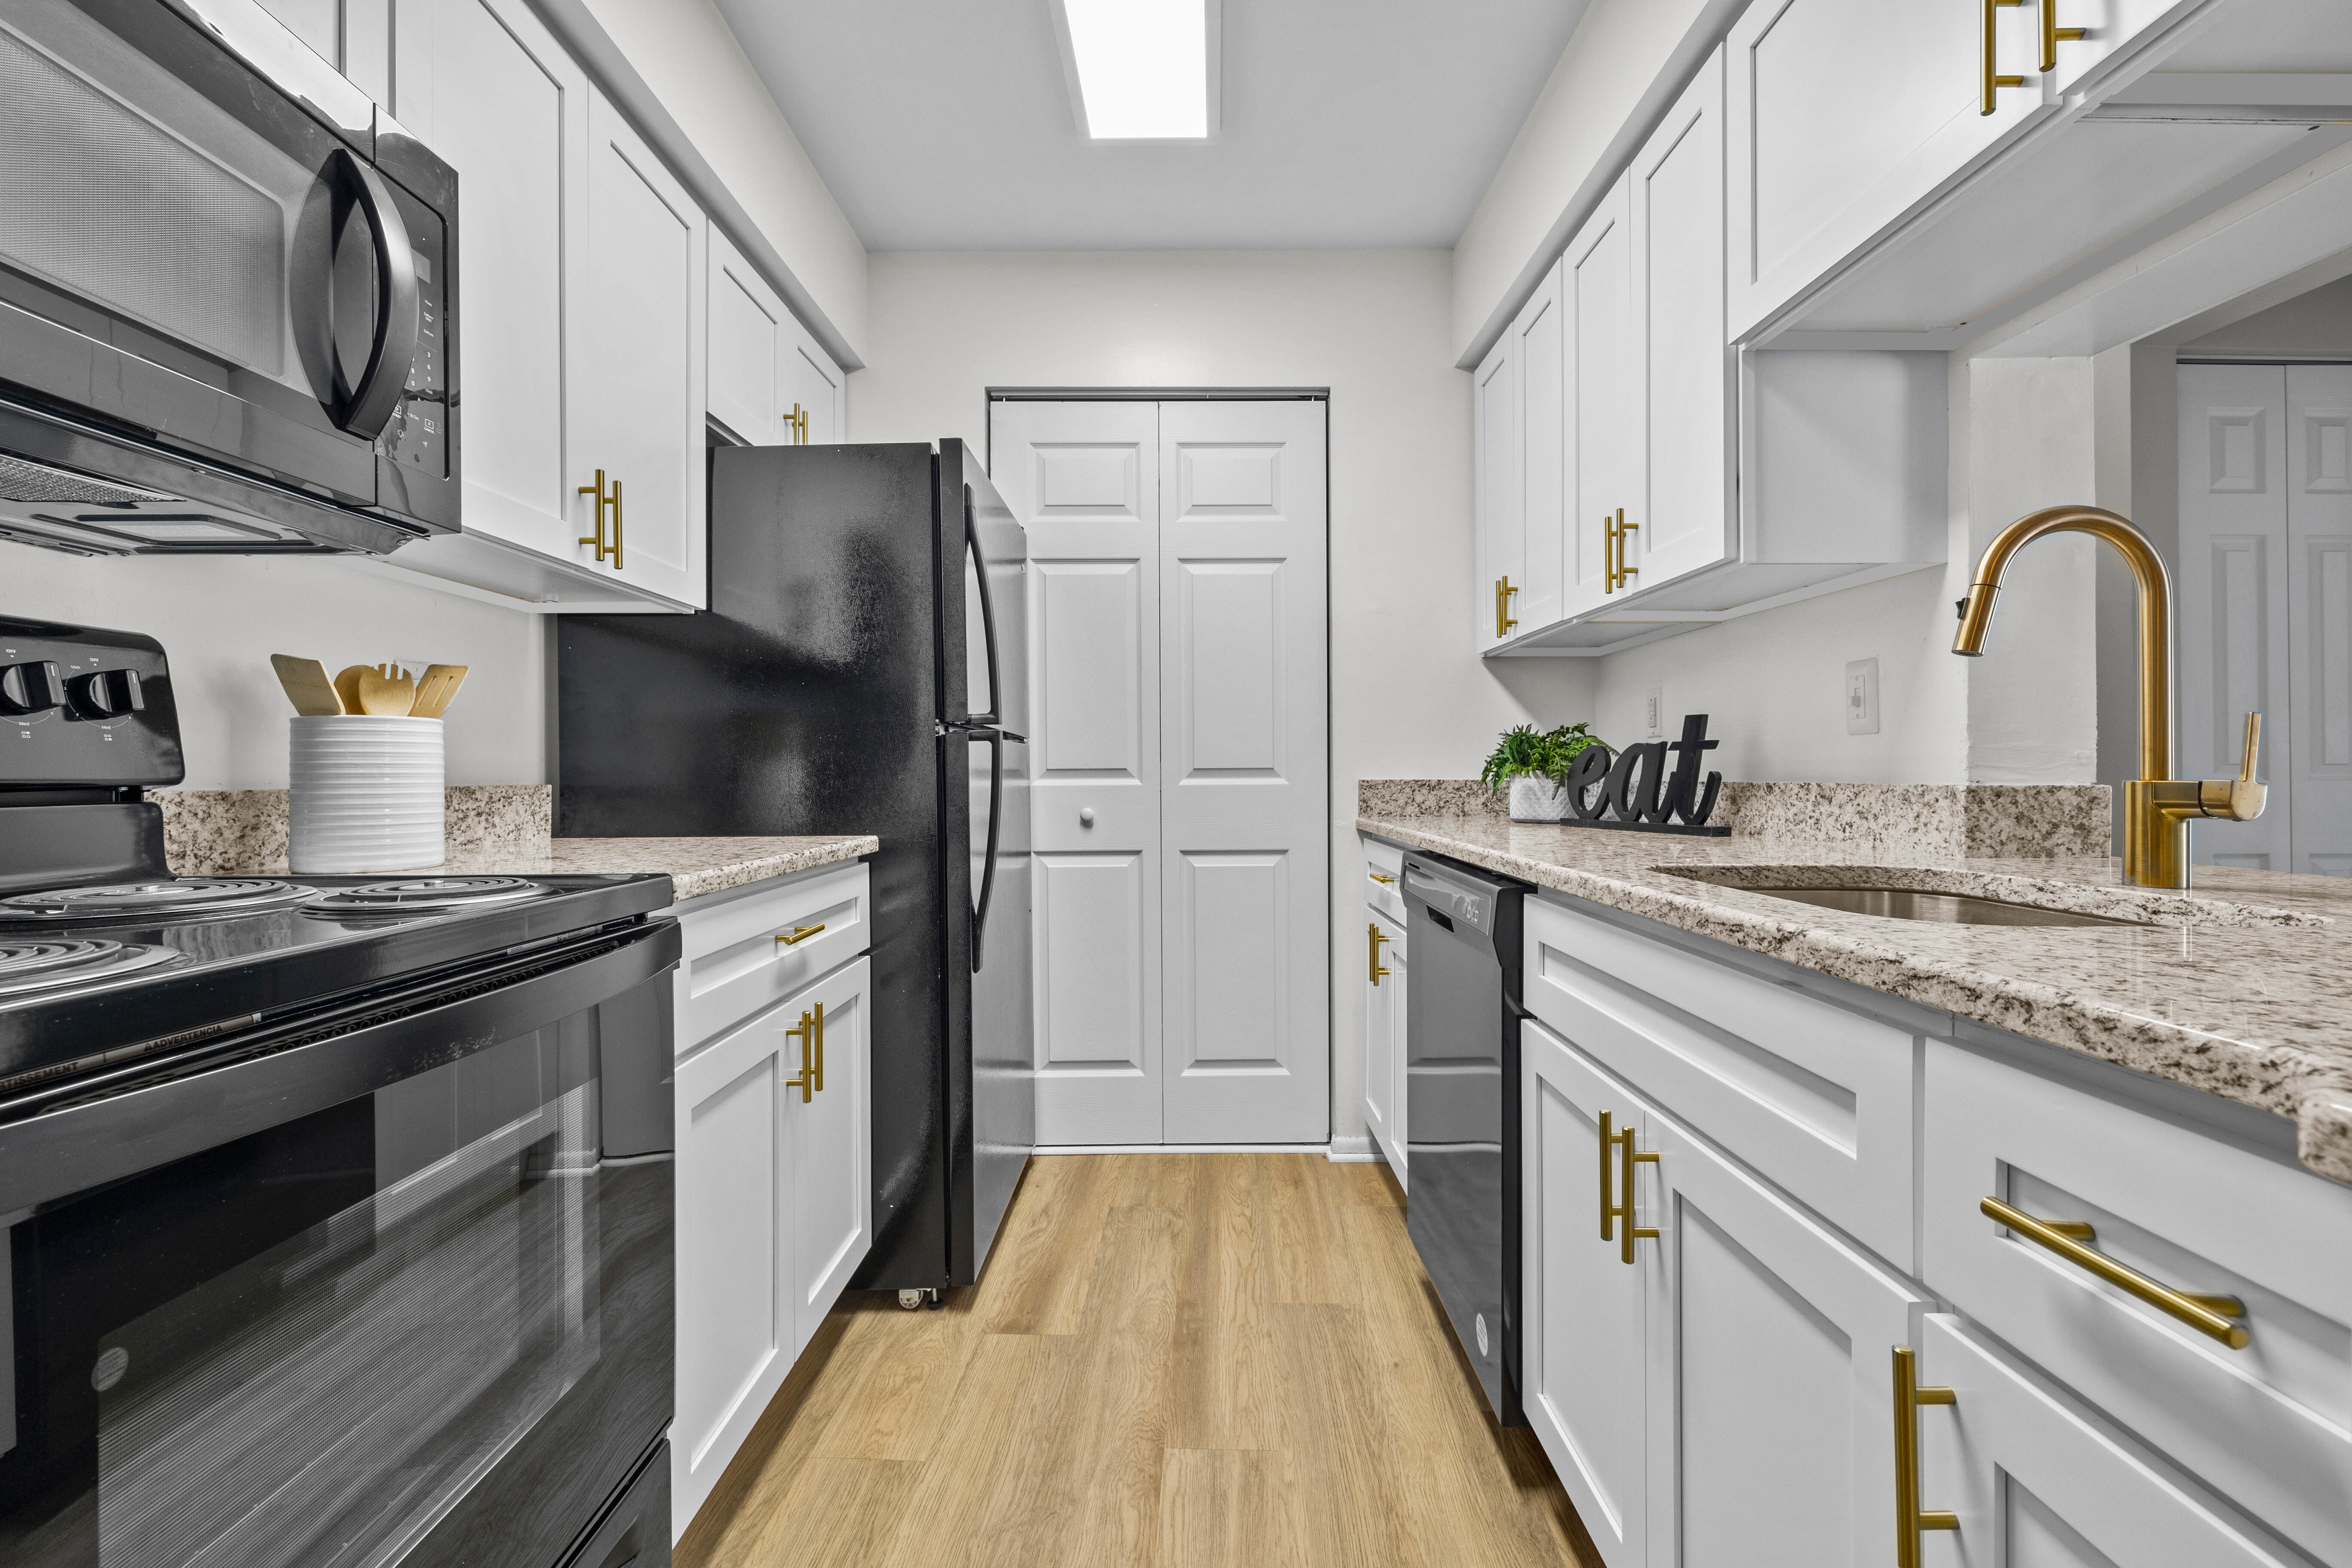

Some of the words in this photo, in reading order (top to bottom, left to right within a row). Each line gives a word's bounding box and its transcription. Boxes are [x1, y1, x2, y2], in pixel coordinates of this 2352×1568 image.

[423, 328, 434, 337] Defrost
[1567, 714, 1722, 826] eat
[152, 1025, 223, 1049] ADVERTENCIA
